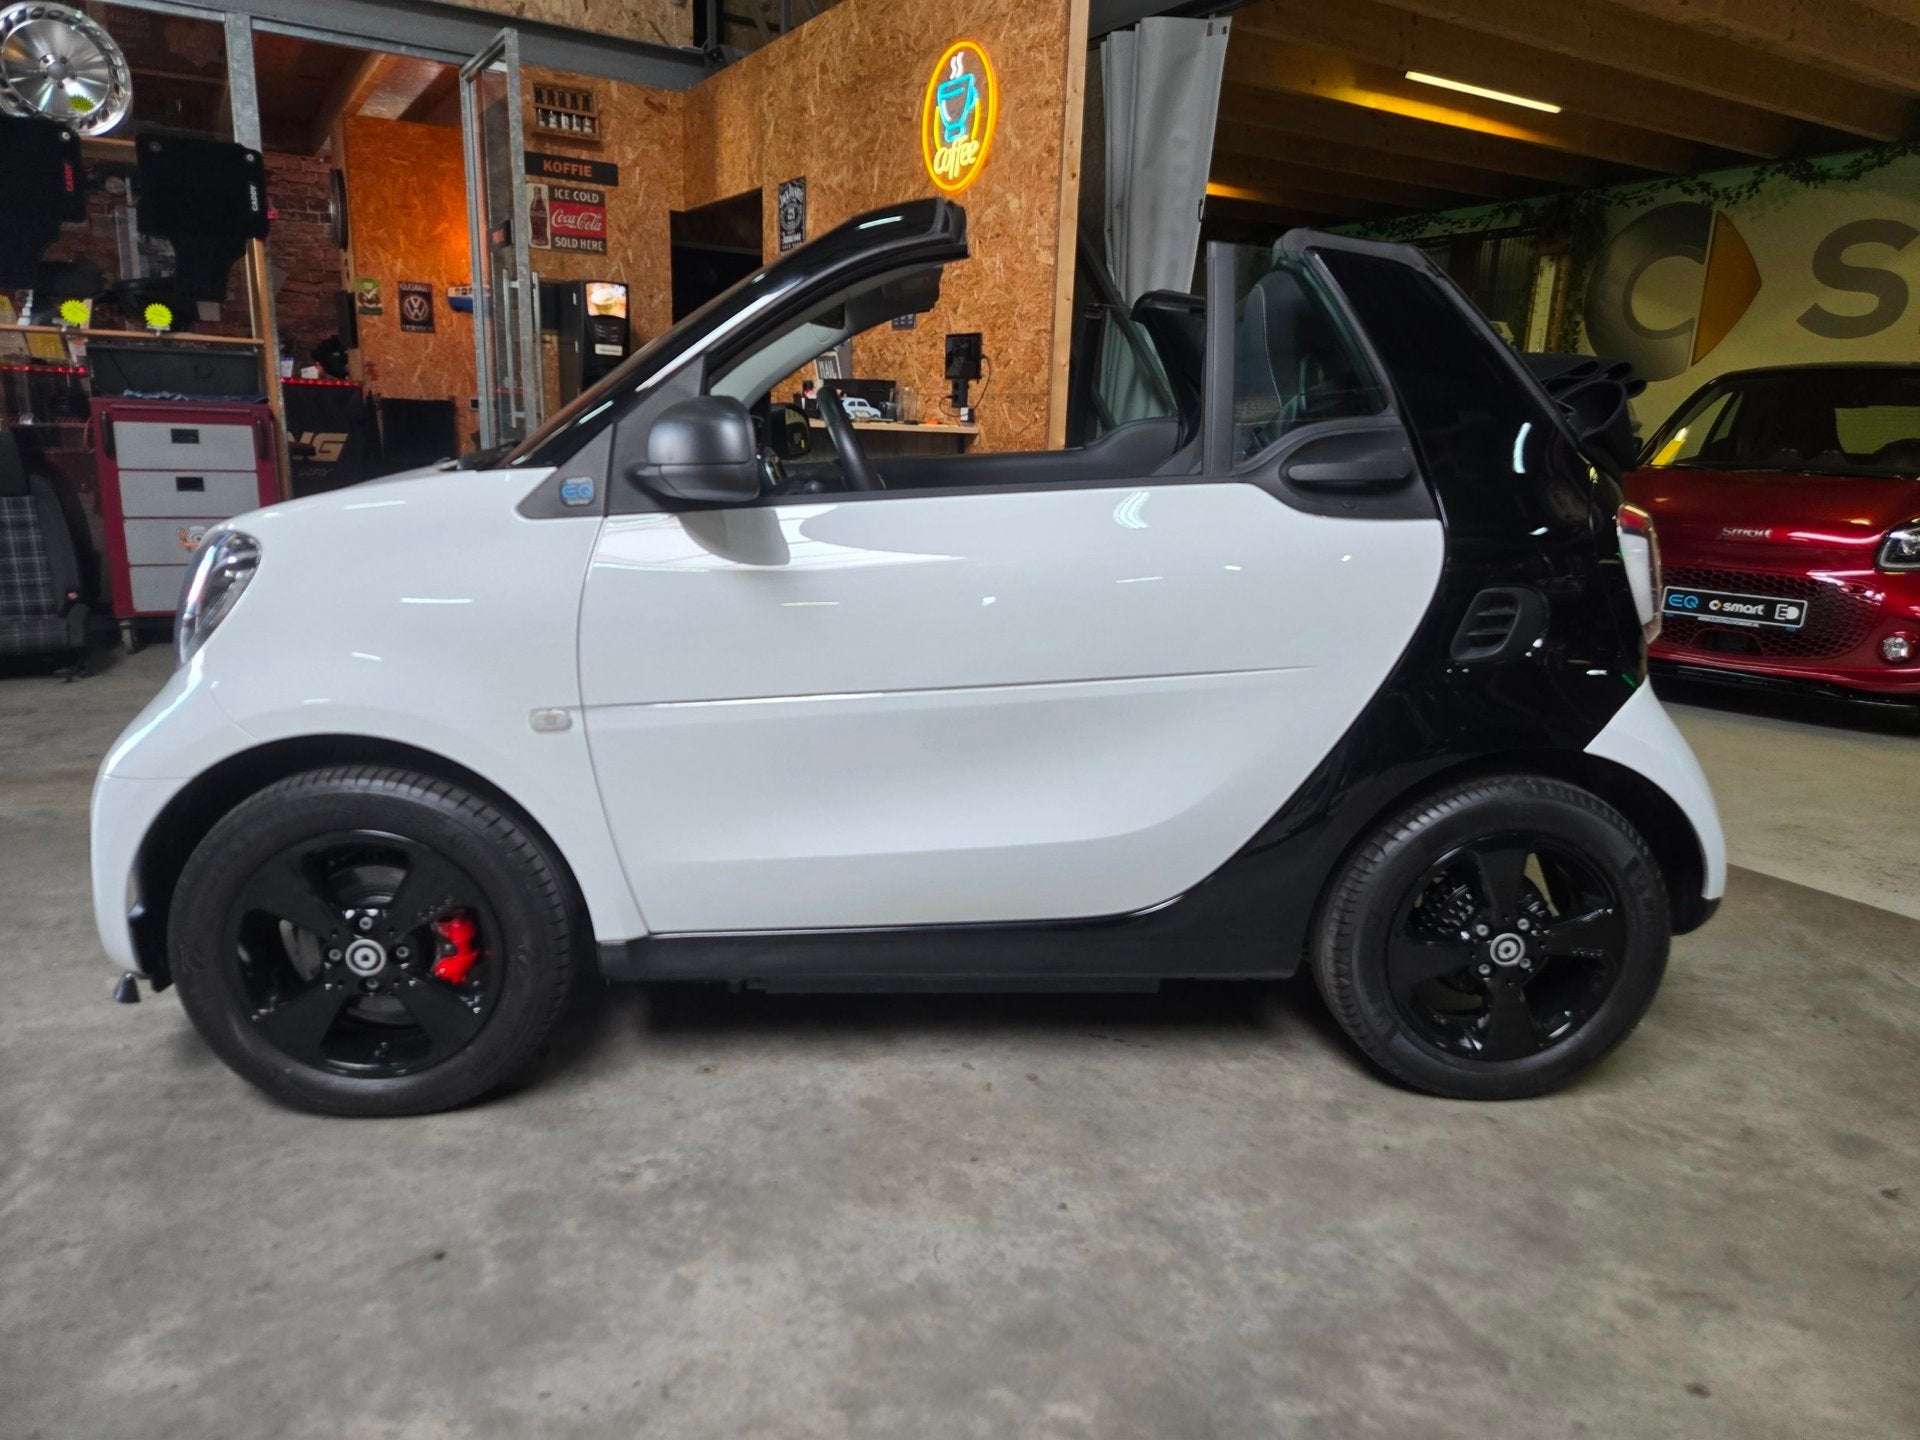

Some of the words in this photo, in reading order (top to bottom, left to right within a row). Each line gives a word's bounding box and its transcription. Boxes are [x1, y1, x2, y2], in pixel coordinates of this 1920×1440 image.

[543, 160, 592, 177] KOFFIE
[250, 184, 258, 211] CADDY
[554, 188, 570, 199] ICE
[573, 190, 600, 203] COLD
[554, 236, 579, 249] SOLD
[580, 238, 604, 252] HERE
[1668, 594, 1699, 609] EQ
[1721, 602, 1765, 616] smart
